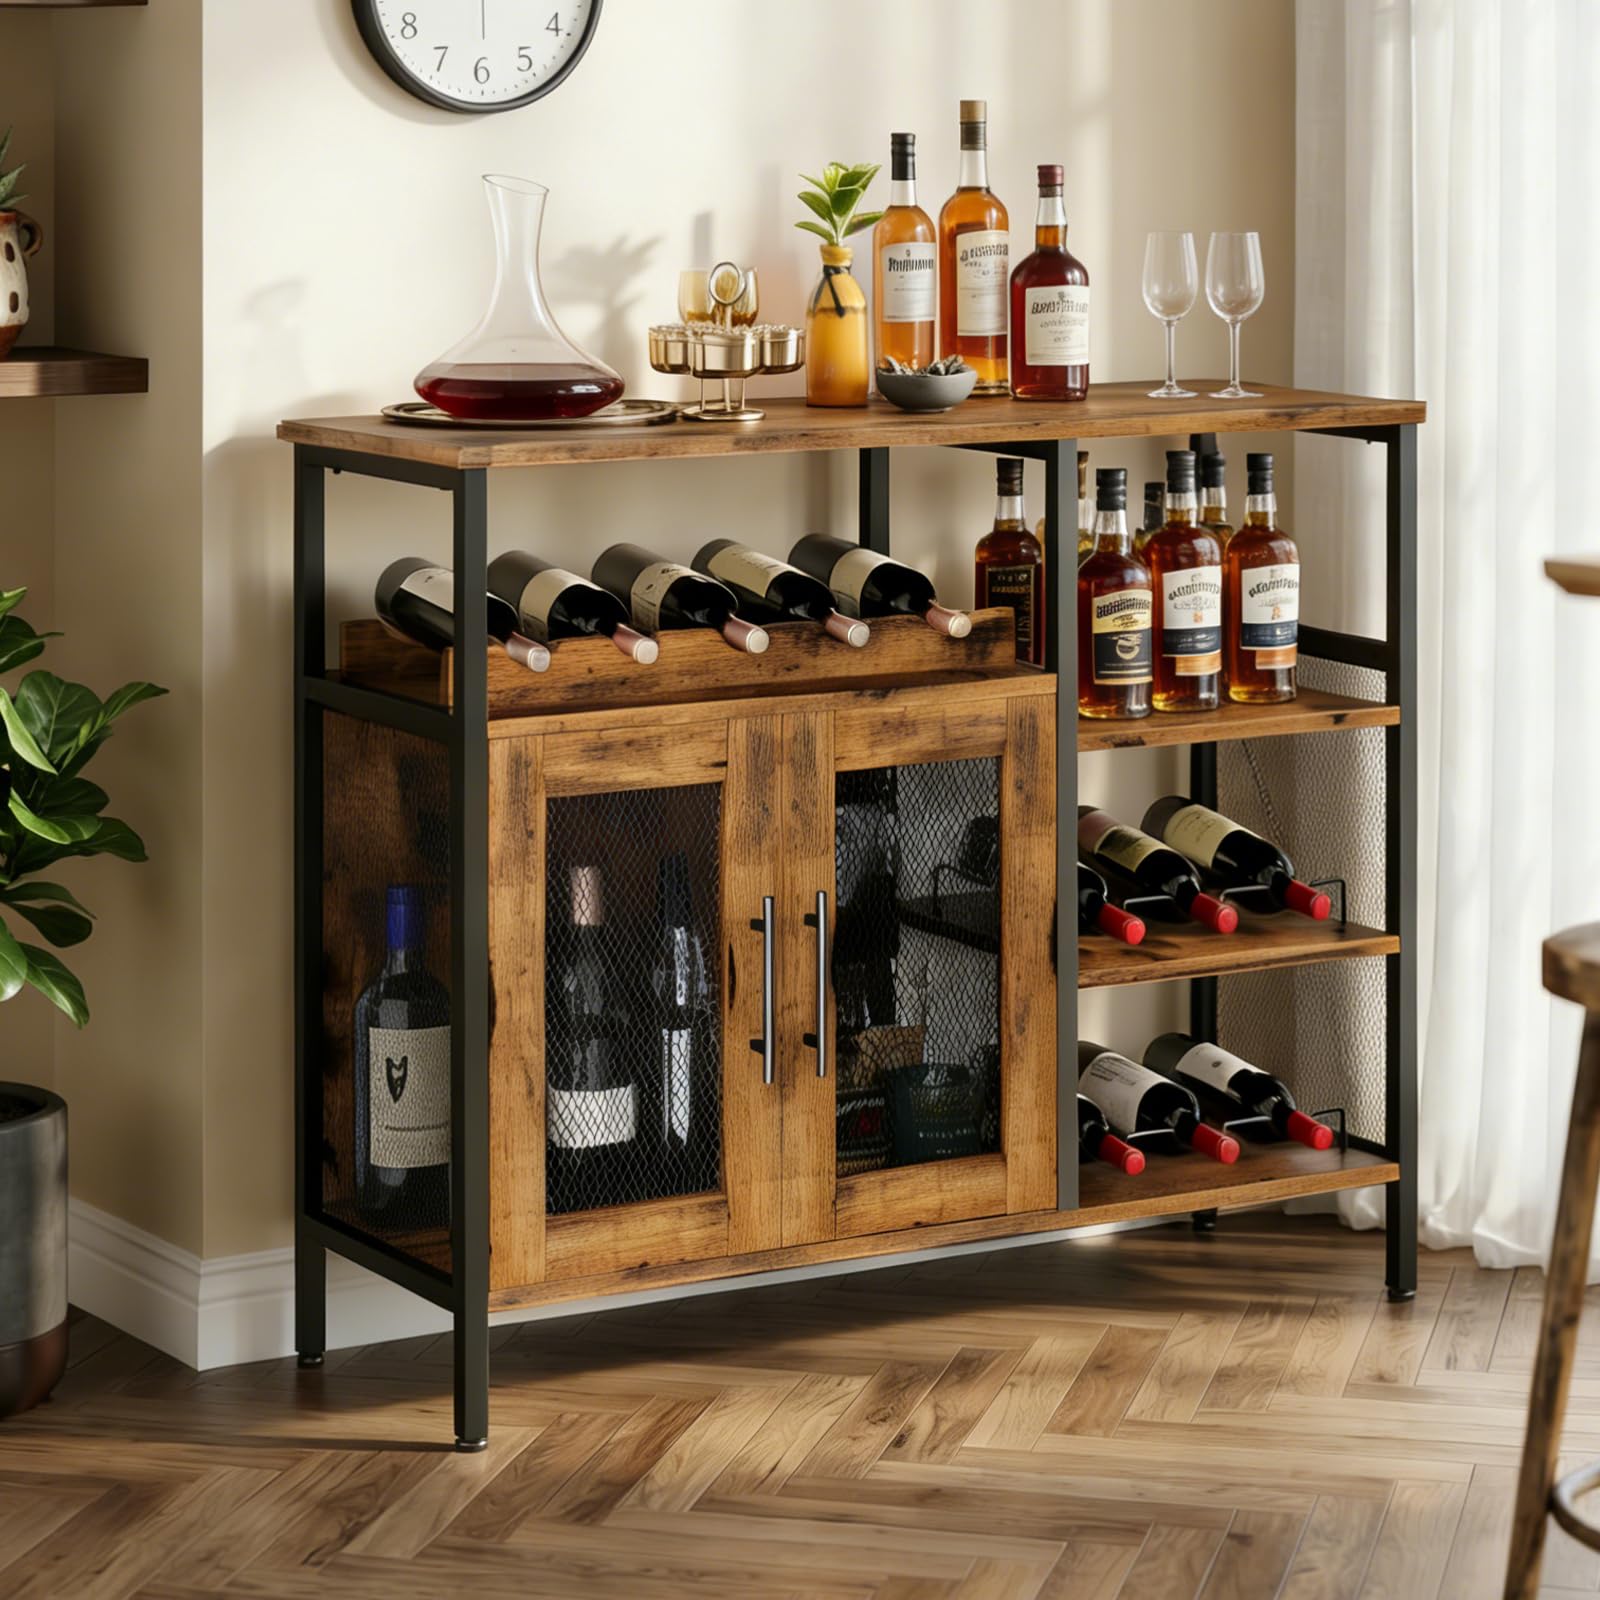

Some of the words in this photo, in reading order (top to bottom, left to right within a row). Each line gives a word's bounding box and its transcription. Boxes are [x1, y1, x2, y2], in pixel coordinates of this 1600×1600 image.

[400, 12, 418, 39] 8
[544, 12, 563, 37] 4
[433, 46, 449, 72] 7
[474, 57, 490, 84] 6
[517, 46, 533, 72] 5
